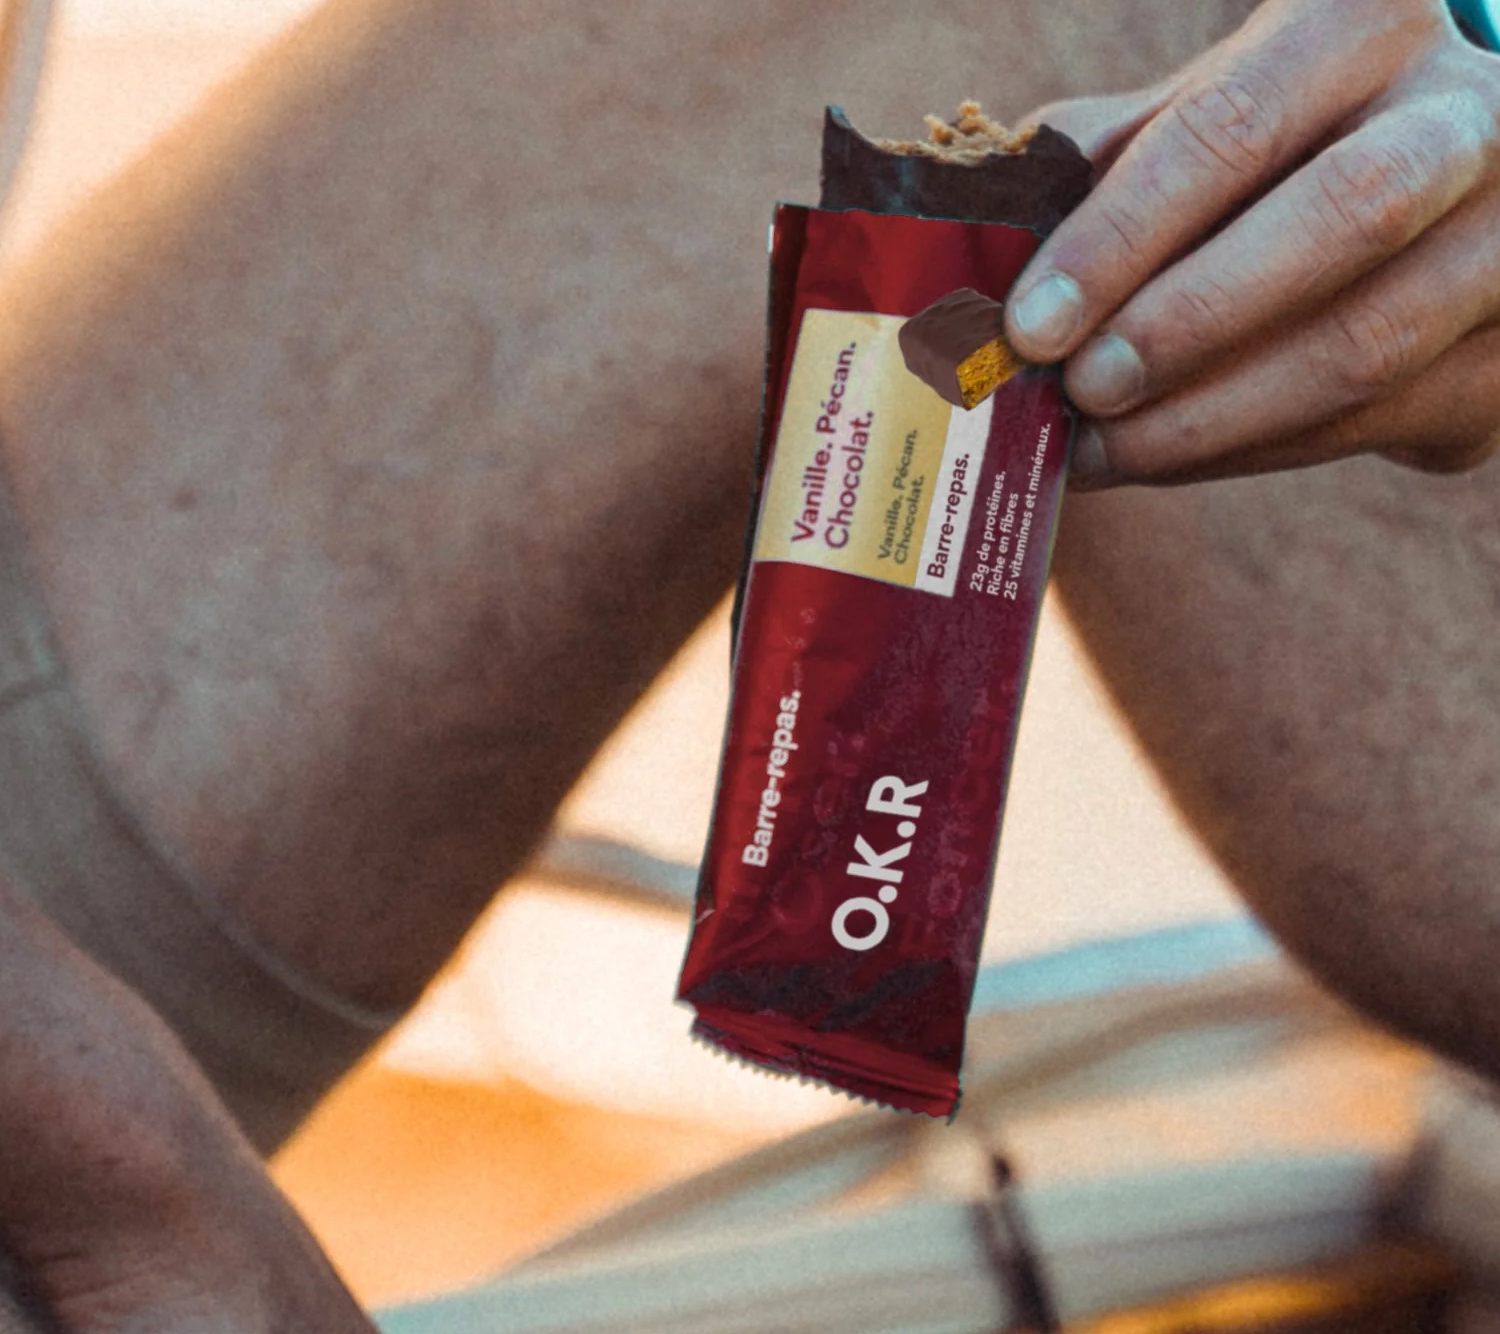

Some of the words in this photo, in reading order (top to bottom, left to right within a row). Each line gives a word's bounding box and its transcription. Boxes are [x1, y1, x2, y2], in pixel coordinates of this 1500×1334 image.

[791, 442, 834, 543] Vanille.
[815, 341, 857, 435] Pécan.
[1027, 422, 1051, 492] minéraux.
[823, 410, 875, 550] Chocolat.
[877, 492, 902, 560] Vanille.
[892, 429, 918, 490] Pécan.
[984, 470, 1007, 542] protéines.
[999, 493, 1019, 532] fibres
[1024, 492, 1037, 511] et
[894, 475, 925, 564] Chocolat.
[927, 453, 971, 579] Barre-repas.
[998, 535, 1011, 554] en
[1008, 512, 1034, 578] vitamines
[970, 564, 990, 592] 23g
[976, 543, 992, 561] de
[986, 555, 1007, 596] Riche
[1003, 581, 1018, 600] 25
[742, 690, 801, 867] Barre-repas.
[831, 775, 929, 951] O.K.R
